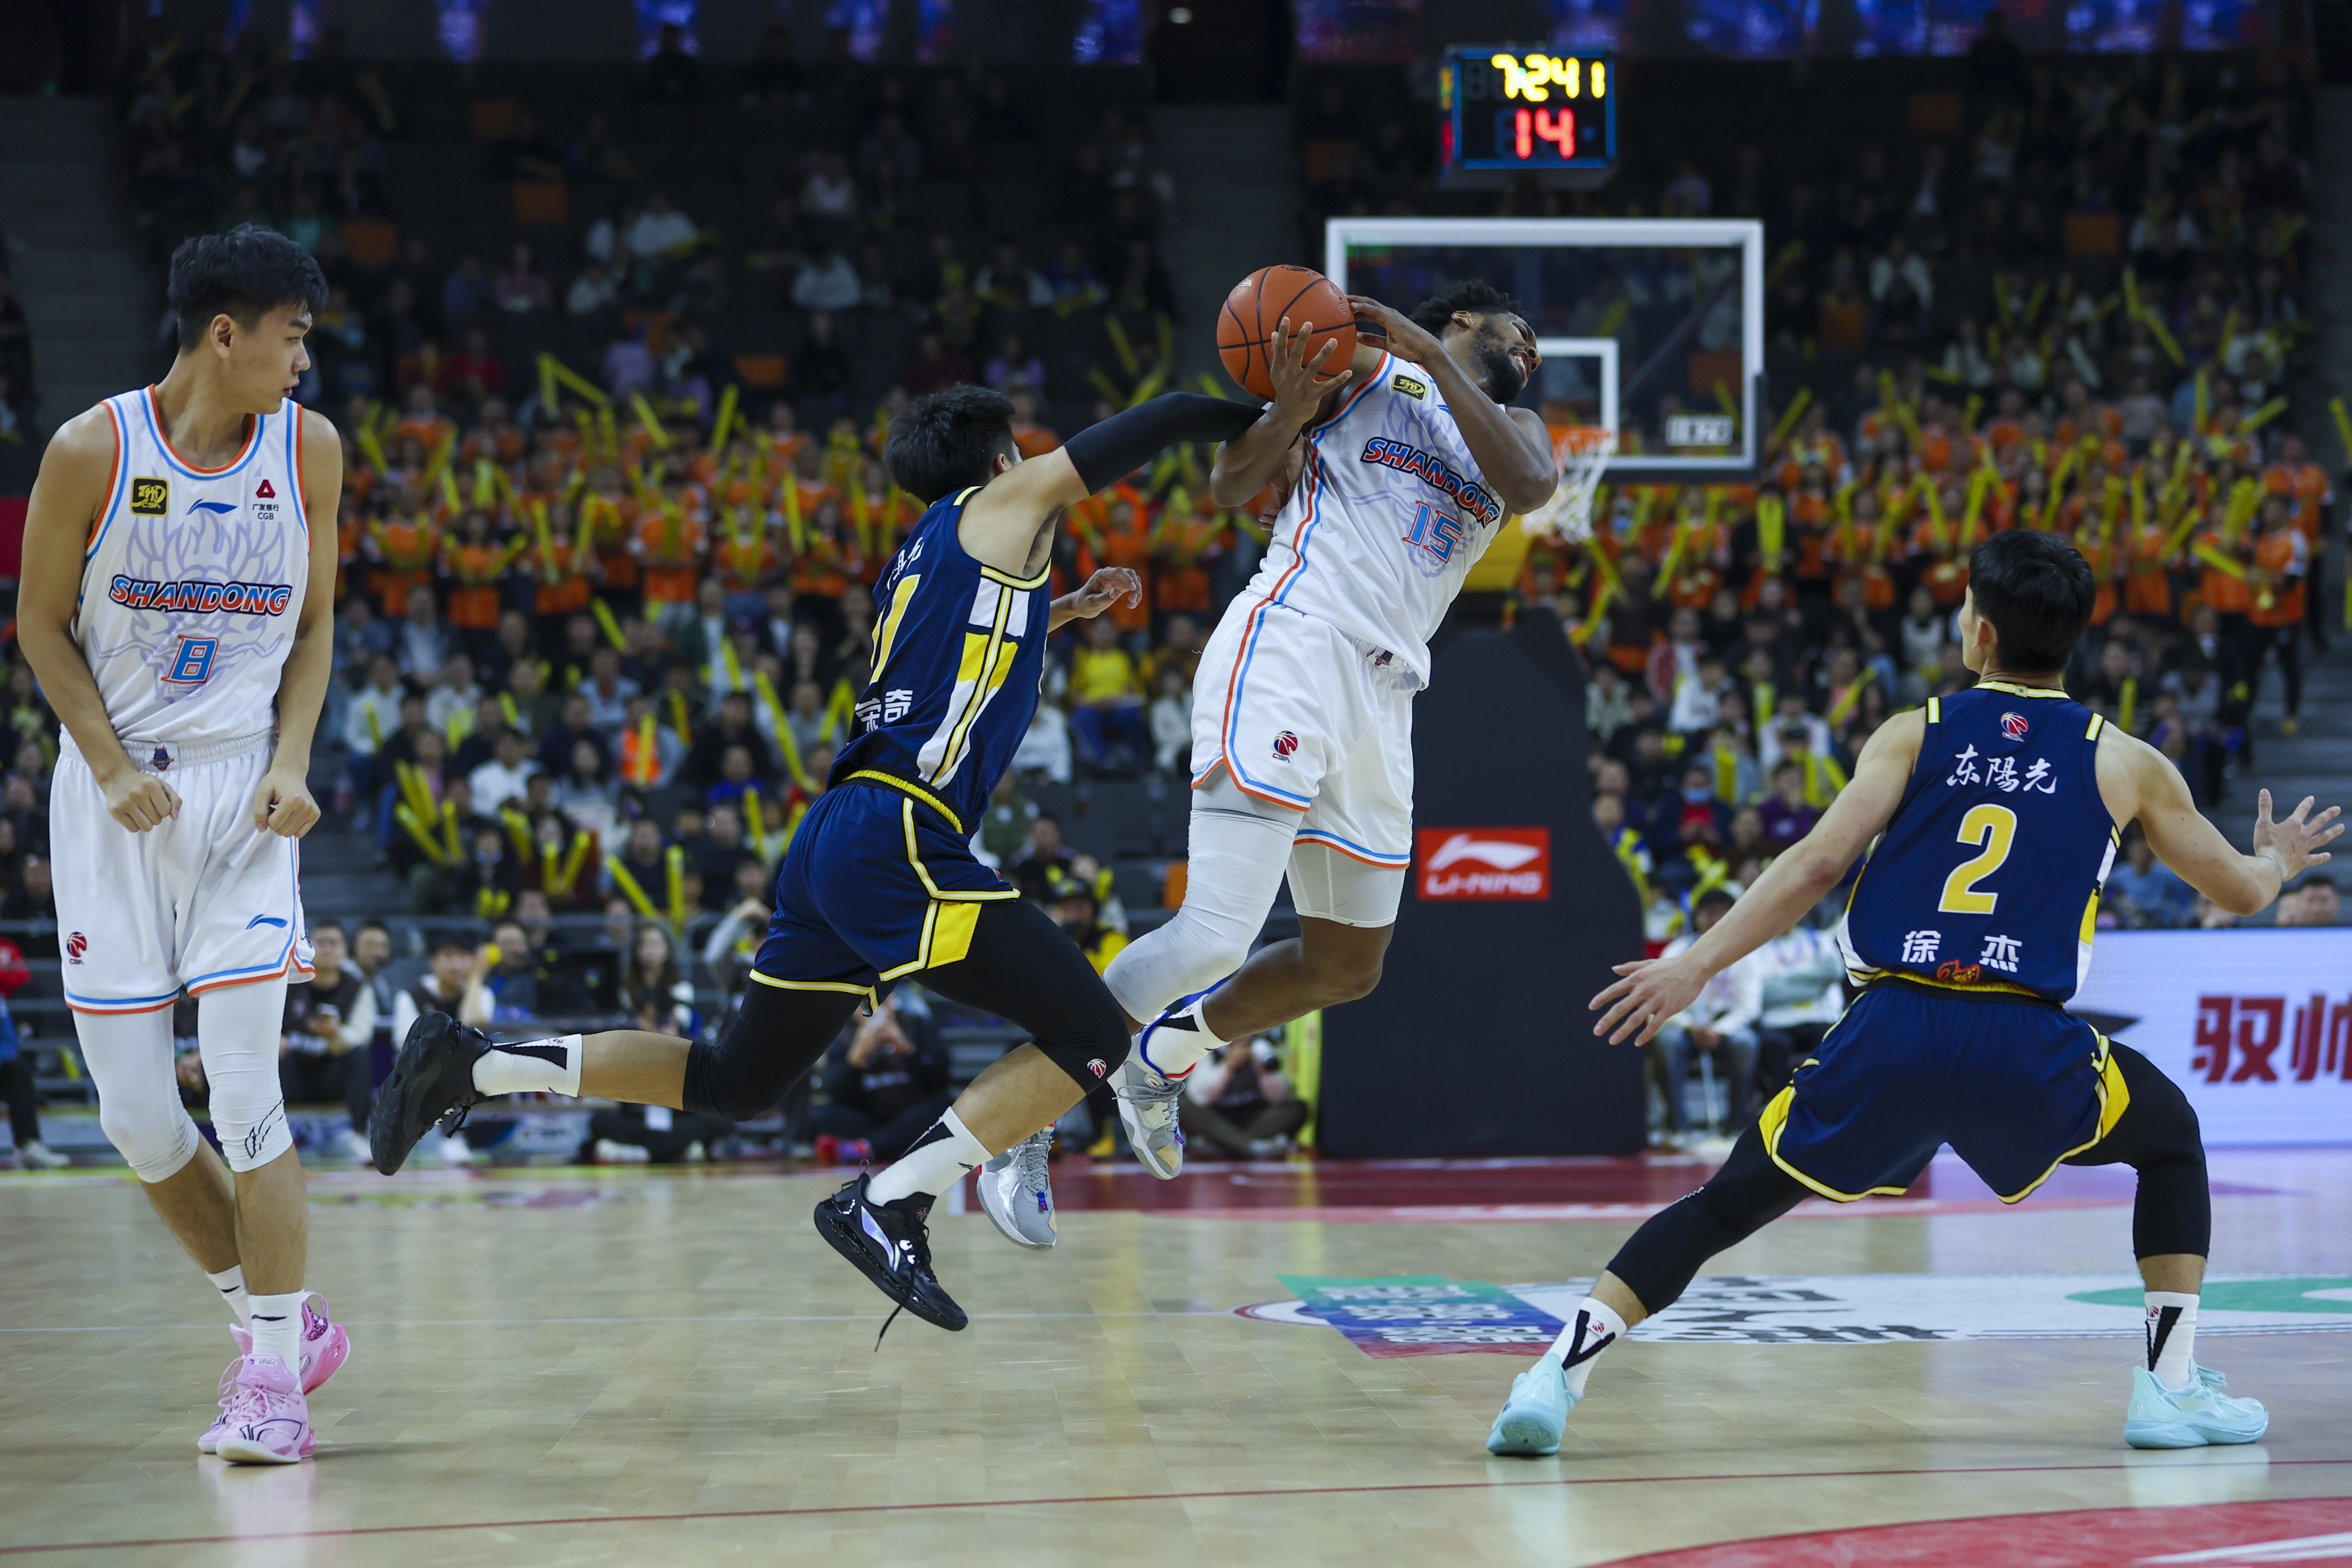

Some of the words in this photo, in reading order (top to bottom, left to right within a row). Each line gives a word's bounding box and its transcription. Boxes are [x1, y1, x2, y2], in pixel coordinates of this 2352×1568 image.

[1515, 107, 1575, 159] 14
[1361, 437, 1501, 529] SHANDONG
[1403, 500, 1462, 563] 15
[109, 575, 292, 615] SHANDONG
[162, 635, 218, 684] 8
[1272, 753, 1291, 763] CBA
[1426, 871, 1543, 895] LI-NING
[1938, 803, 2017, 915] 2
